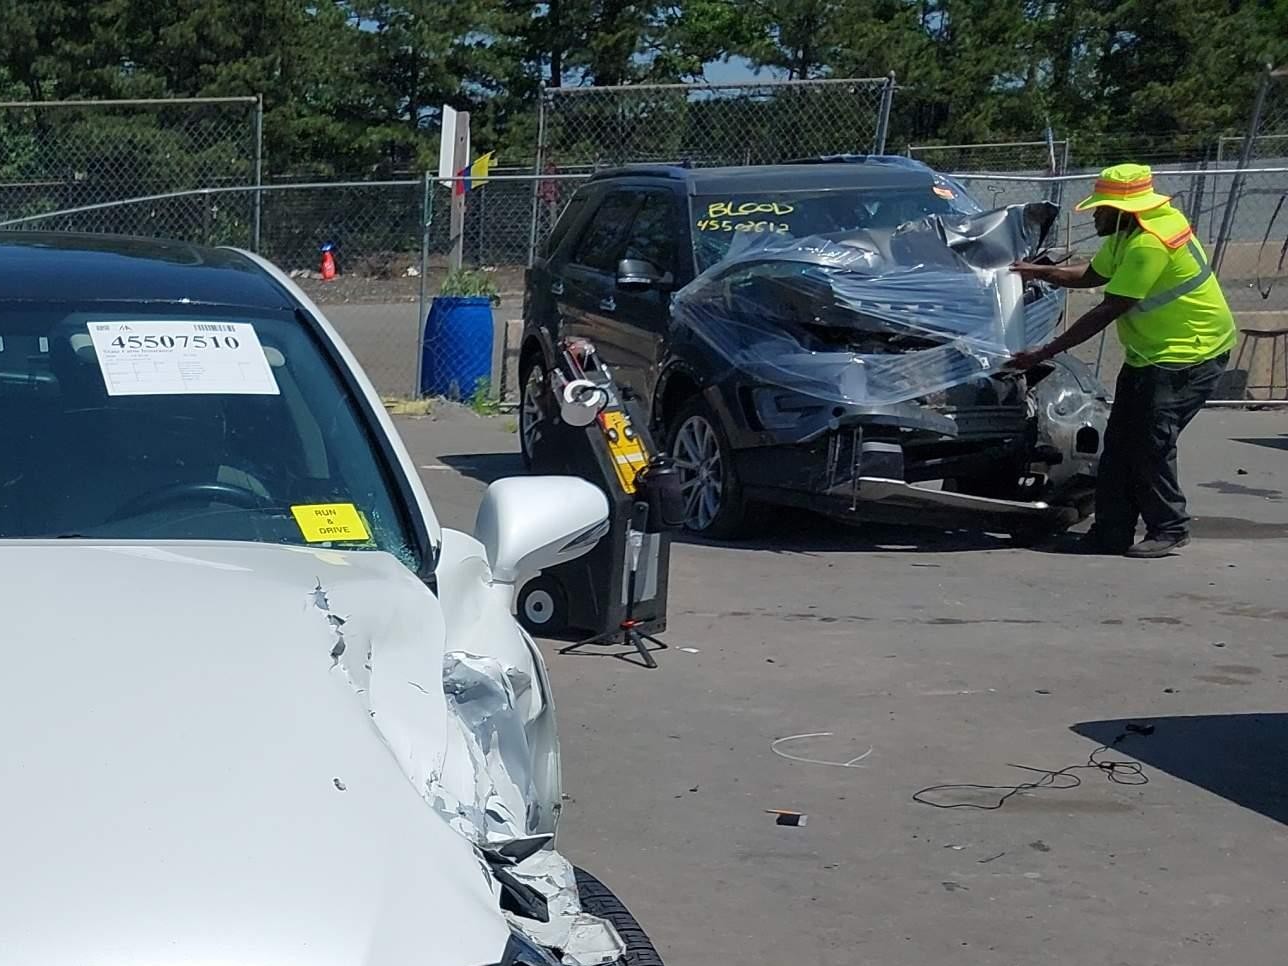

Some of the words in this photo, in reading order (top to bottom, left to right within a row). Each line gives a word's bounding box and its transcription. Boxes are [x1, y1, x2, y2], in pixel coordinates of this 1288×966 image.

[708, 201, 794, 218] BLOOD
[111, 335, 240, 350] 45507510
[314, 509, 337, 517] RUN
[319, 526, 351, 535] DRIVE
